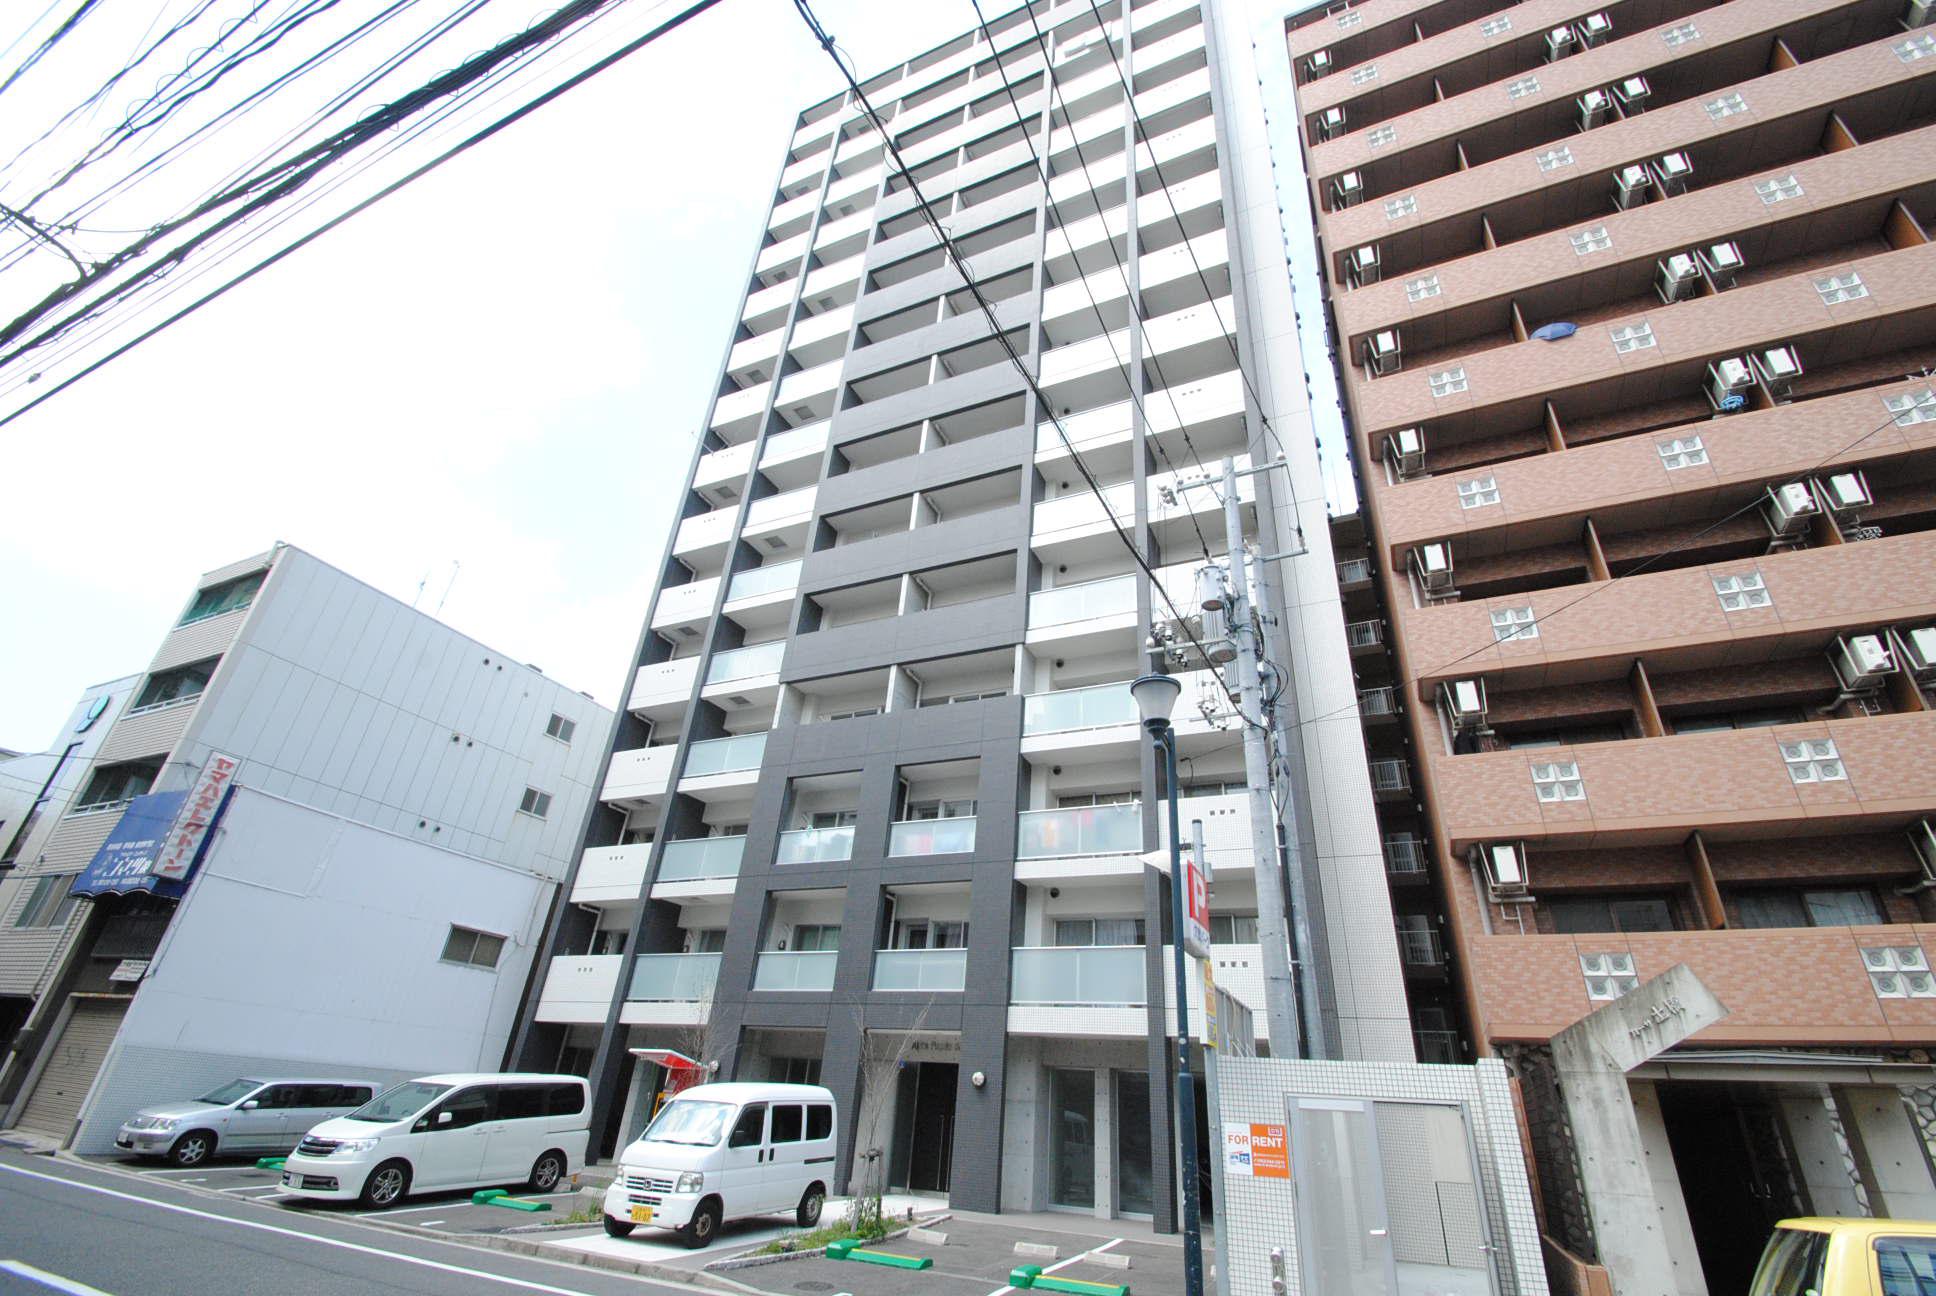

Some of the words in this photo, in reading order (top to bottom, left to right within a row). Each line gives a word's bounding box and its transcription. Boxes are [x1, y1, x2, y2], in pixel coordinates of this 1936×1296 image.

[164, 758, 234, 873] ヤマハエレクトーン
[1192, 869, 1206, 918] P
[1228, 1135, 1249, 1145] FOR
[1252, 1136, 1283, 1148] RENT
